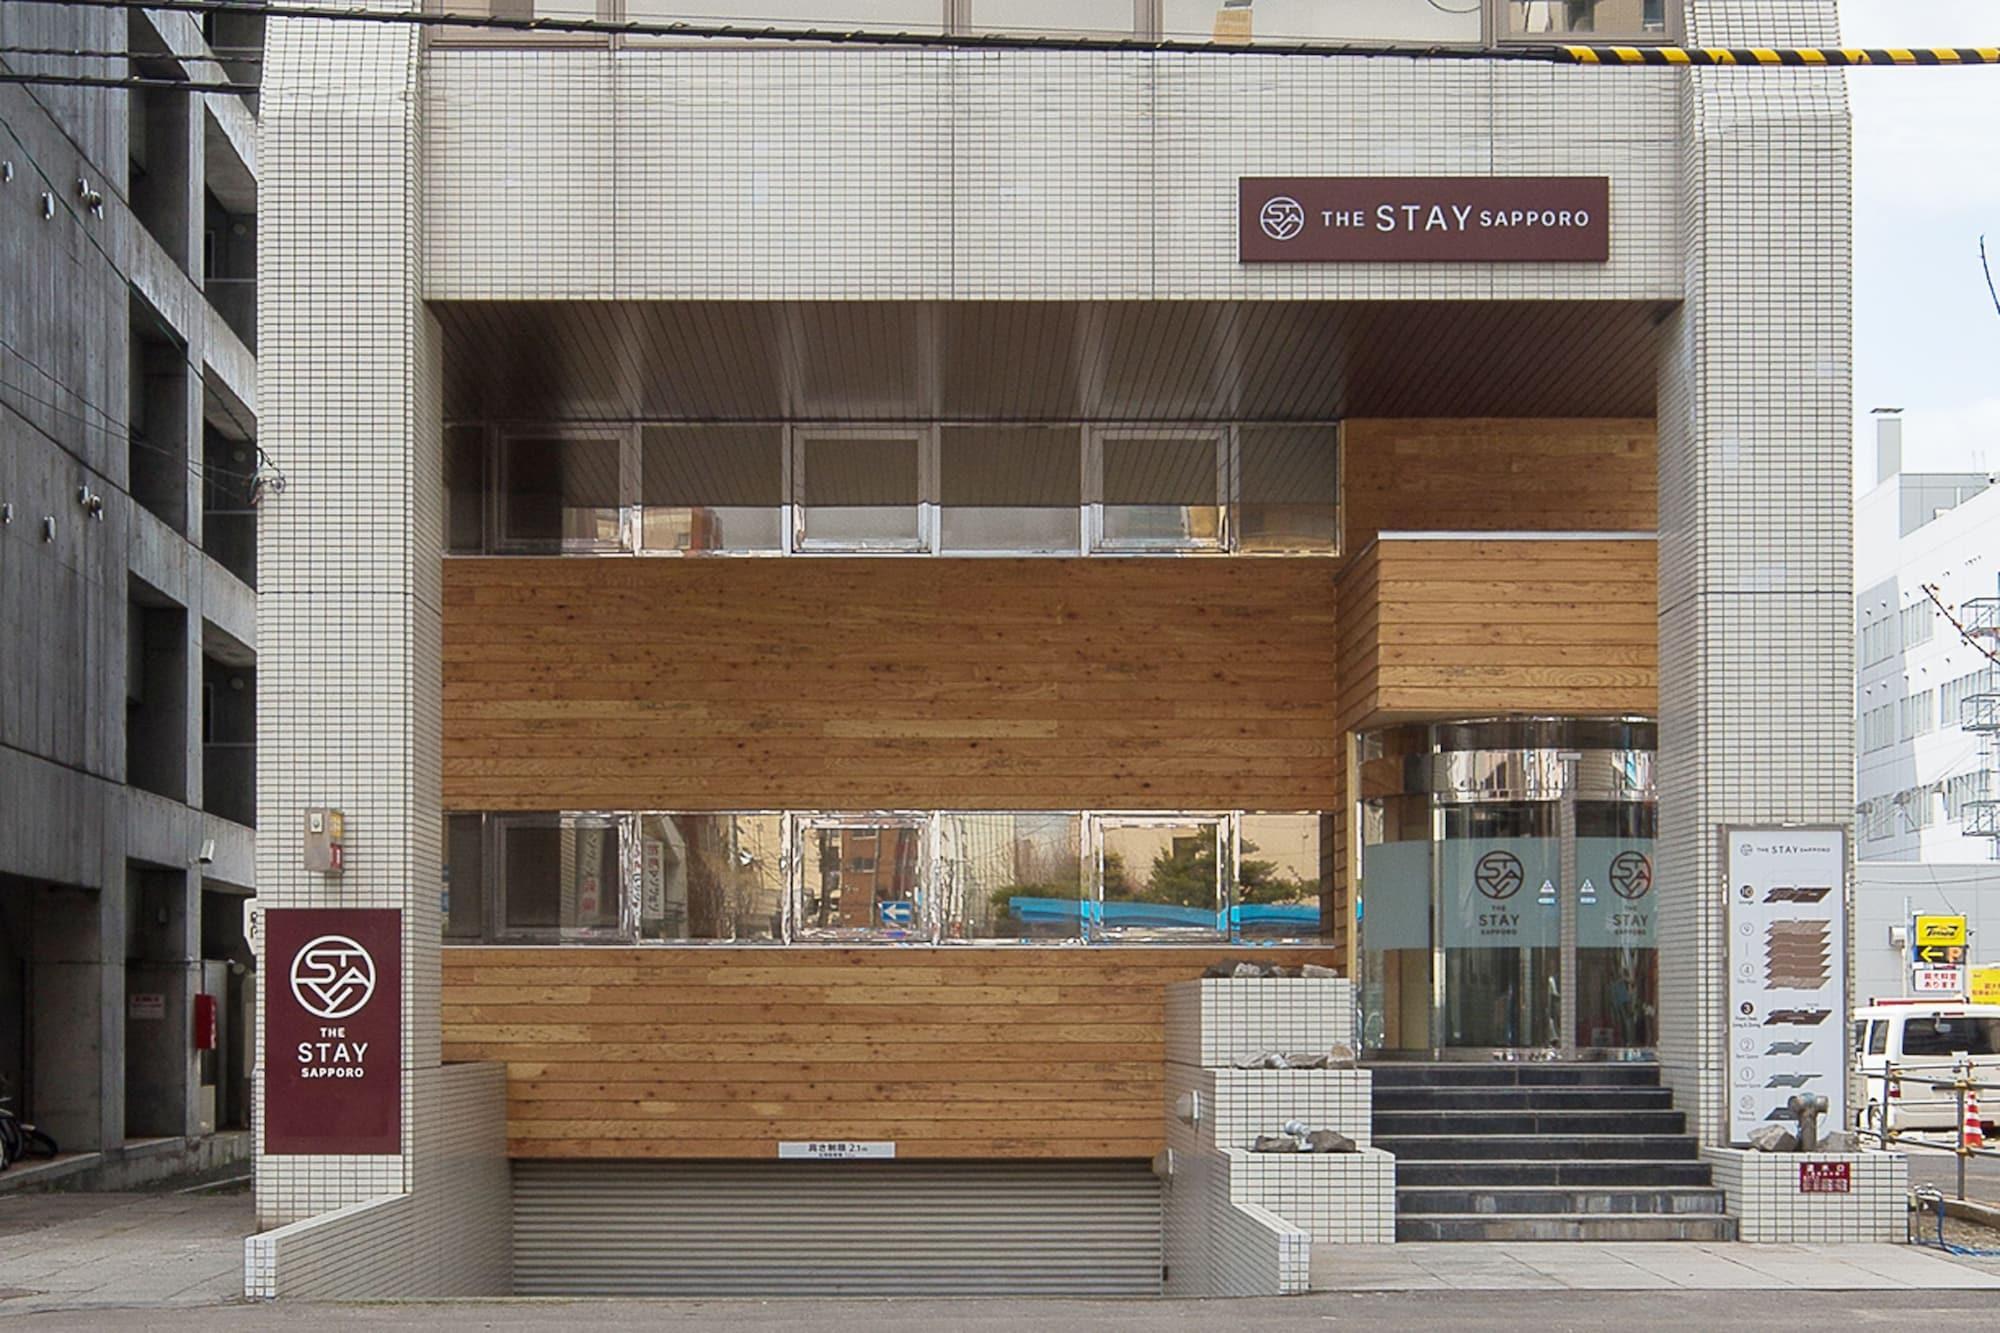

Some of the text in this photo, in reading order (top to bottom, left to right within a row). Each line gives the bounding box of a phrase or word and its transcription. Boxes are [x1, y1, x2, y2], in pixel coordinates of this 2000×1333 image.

[1321, 205, 1590, 232] THE STAY SAPPORO
[1771, 845, 1798, 854] STAY
[1479, 914, 1520, 926] STAY
[1613, 914, 1648, 926] STAY
[320, 1027, 345, 1038] THE
[298, 1042, 368, 1063] STAY
[301, 1067, 364, 1078] SAPPORO
